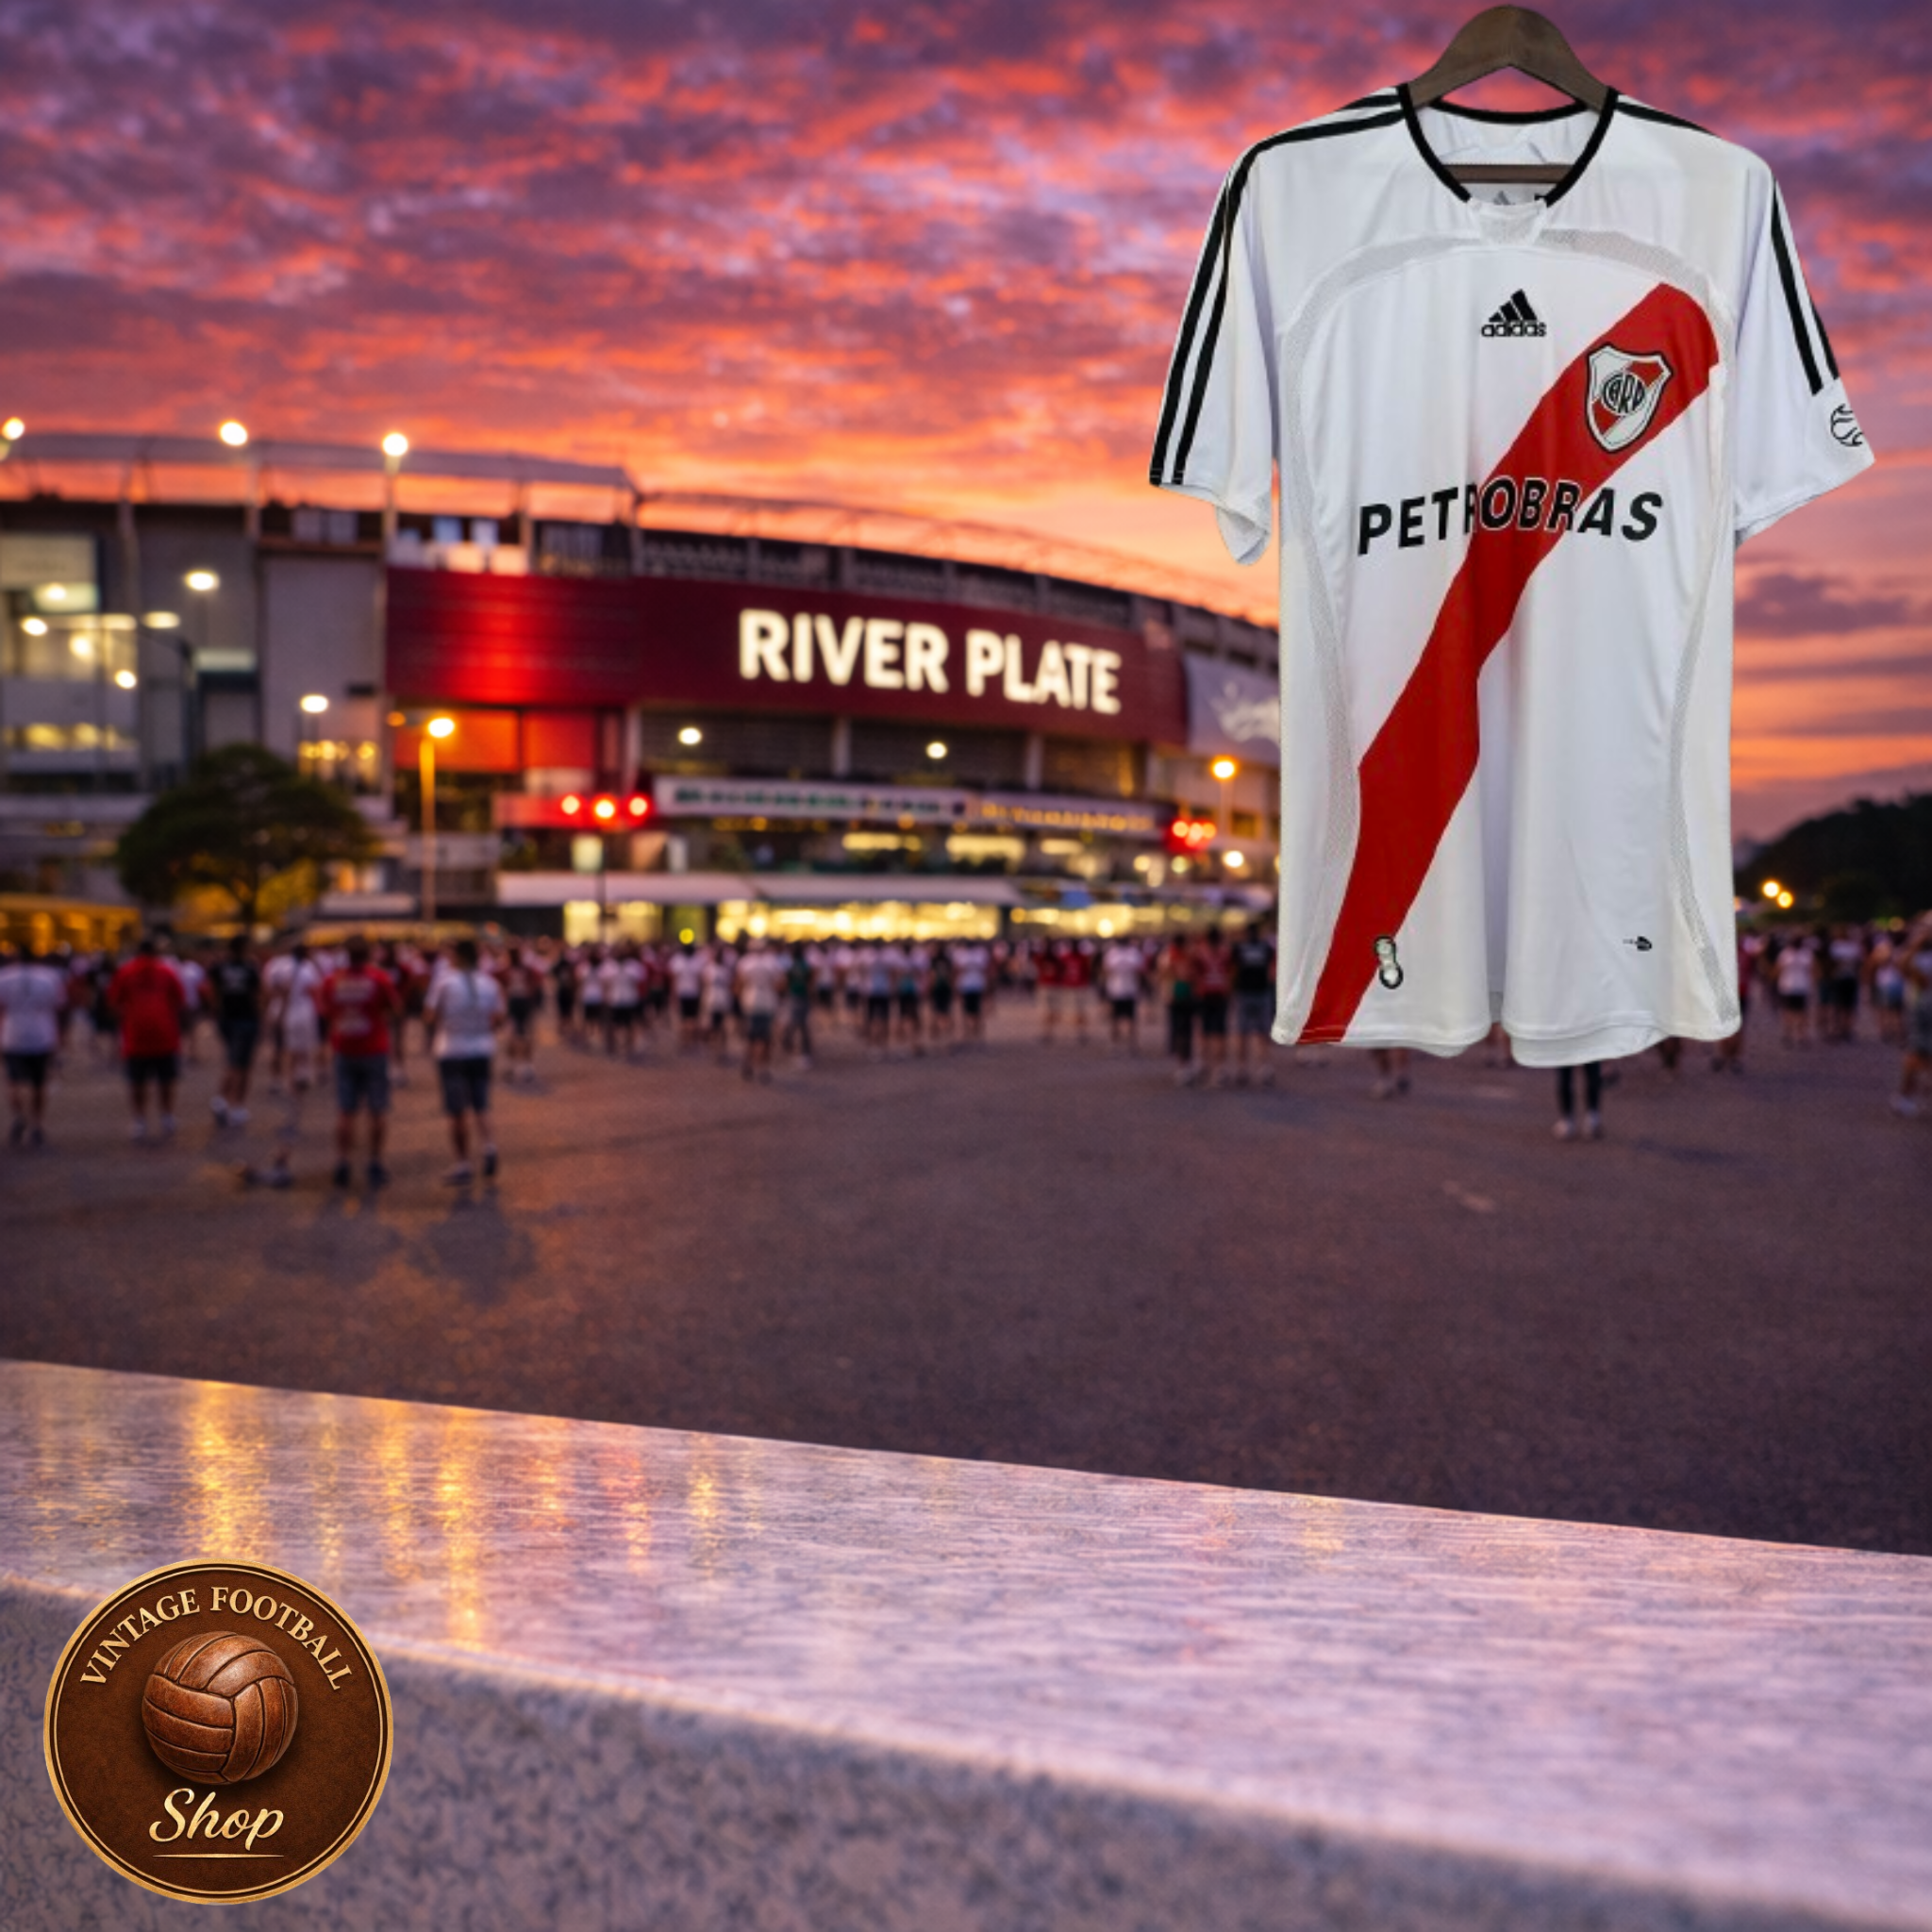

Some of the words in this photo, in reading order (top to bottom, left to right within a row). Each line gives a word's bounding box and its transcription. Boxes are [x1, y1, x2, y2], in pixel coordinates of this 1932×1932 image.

[1481, 321, 1547, 338] adidas
[1357, 475, 1663, 557] PETROBRAS
[739, 608, 950, 694] RIVER
[965, 627, 1123, 716] PLATE
